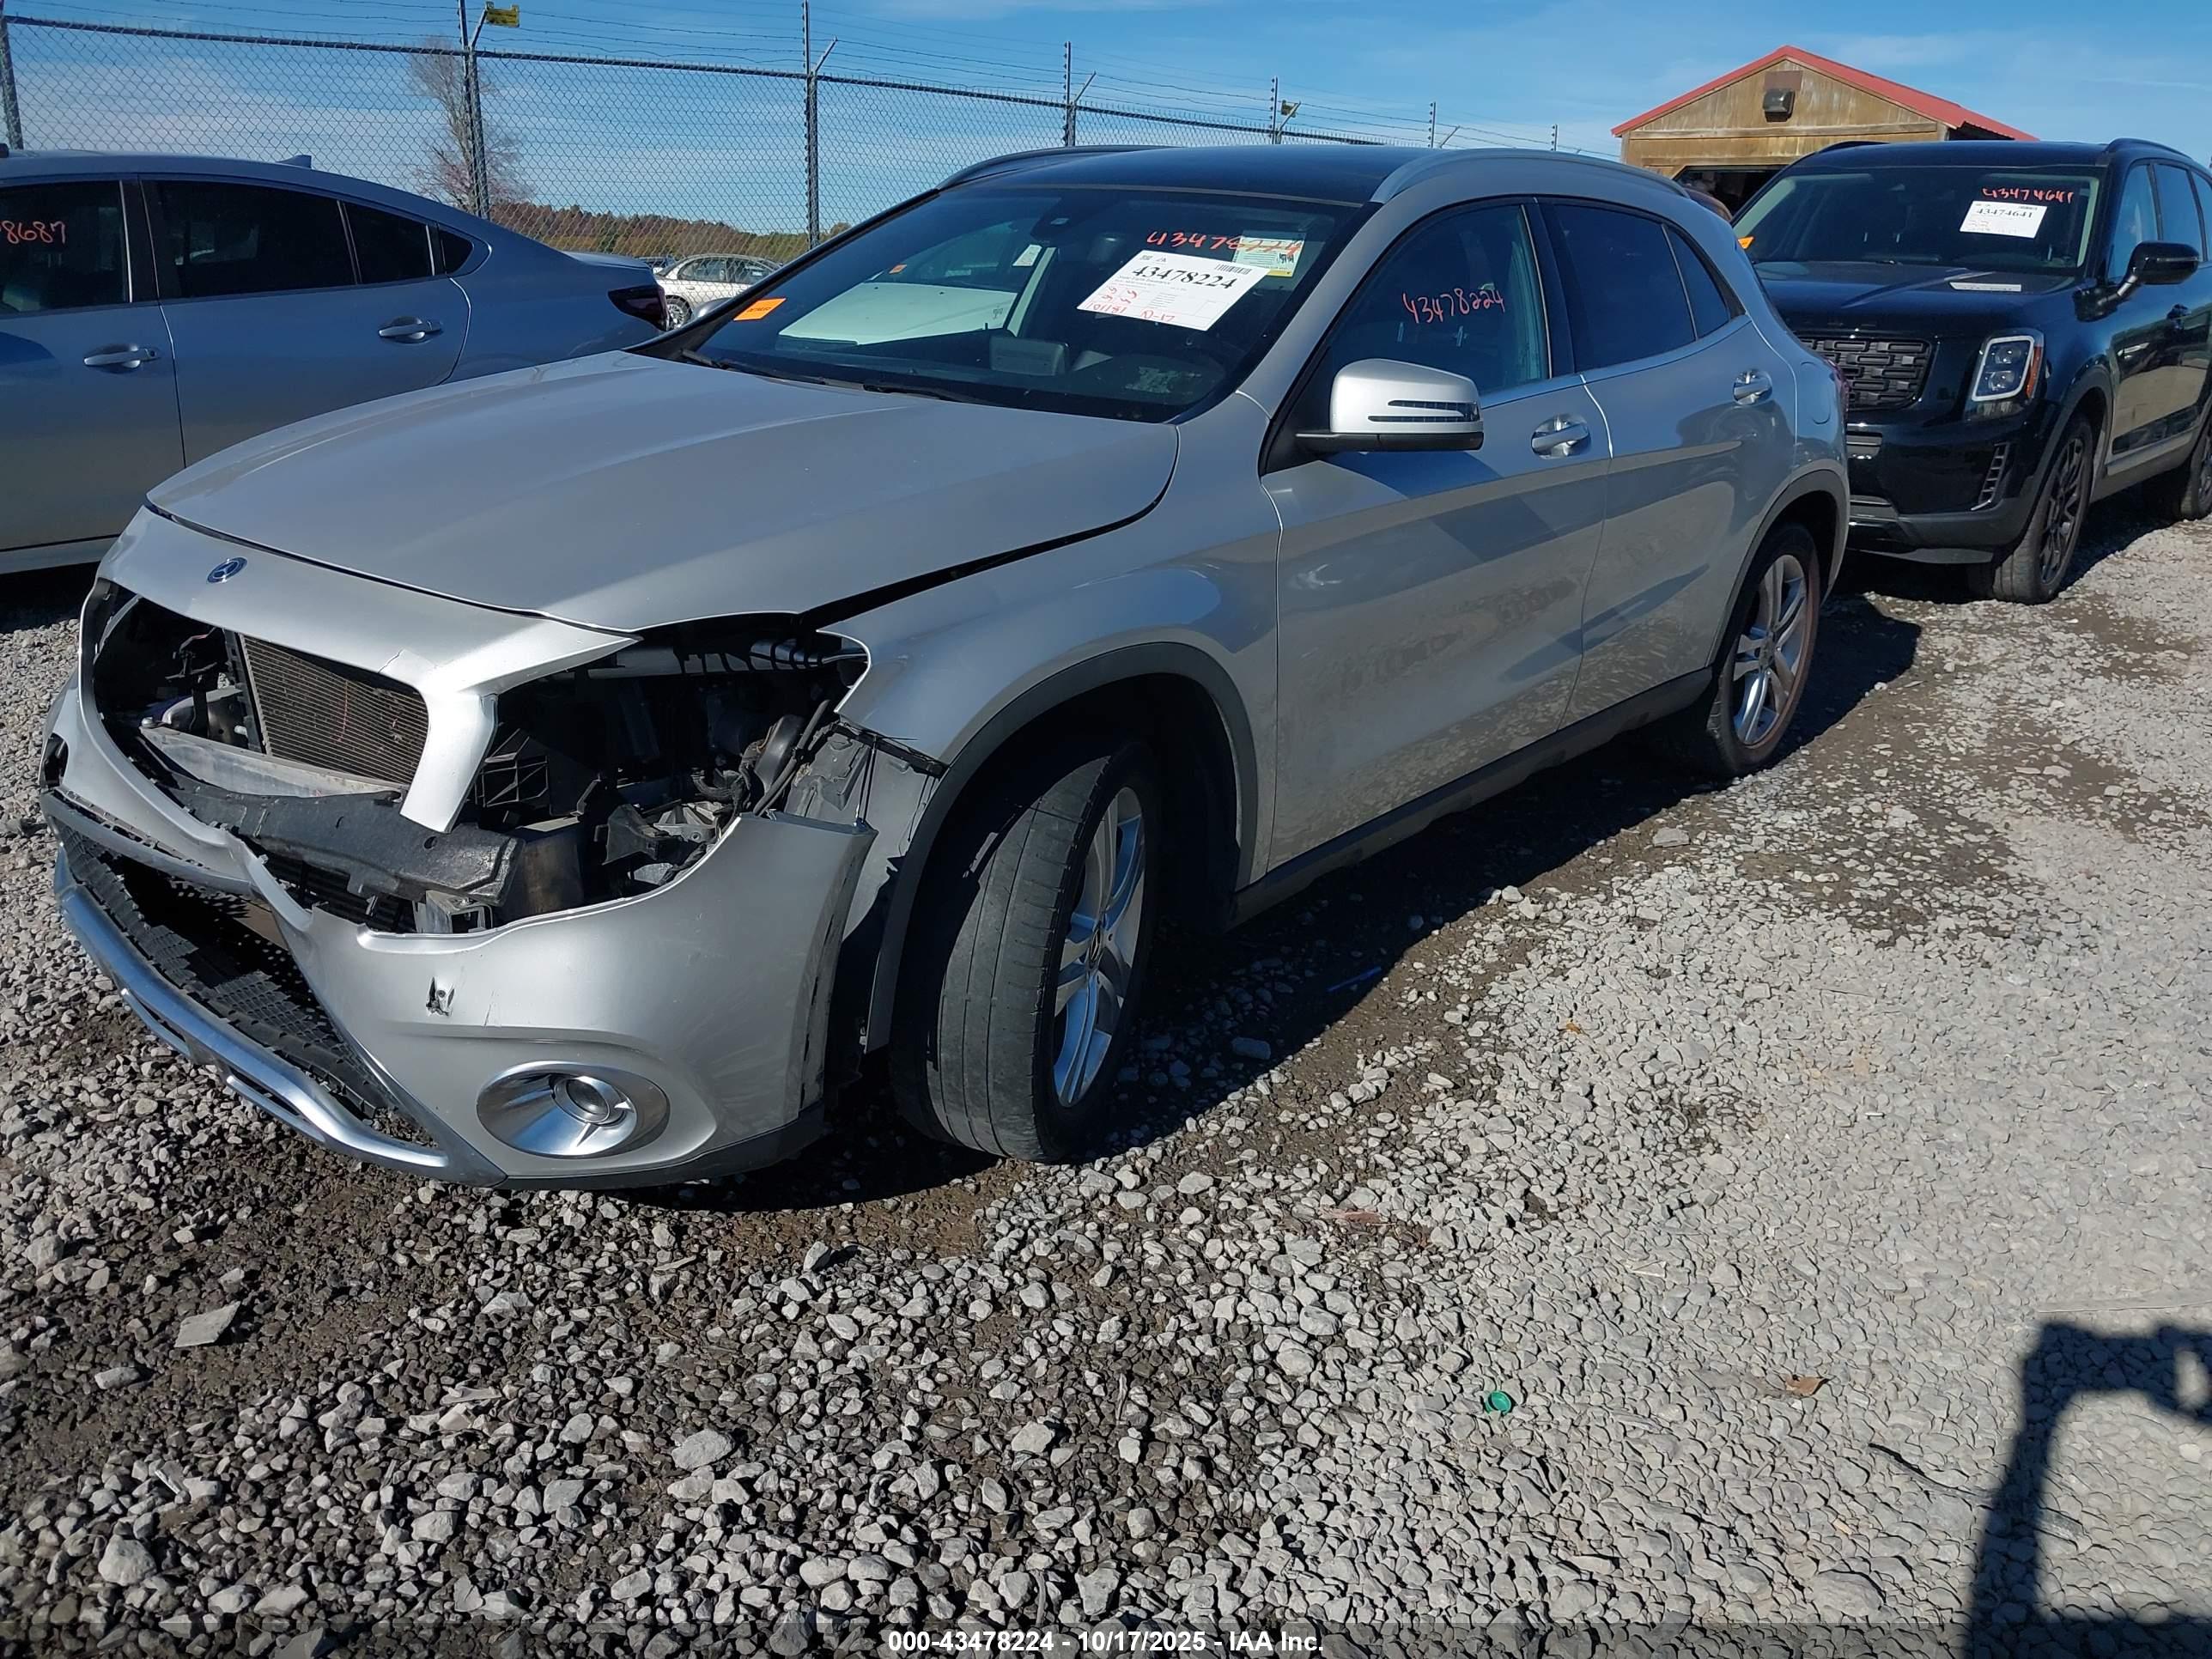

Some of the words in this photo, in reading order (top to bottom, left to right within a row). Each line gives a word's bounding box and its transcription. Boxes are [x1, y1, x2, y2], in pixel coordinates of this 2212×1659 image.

[1982, 187, 2075, 204] 43474641
[1976, 208, 2033, 218] 43474641
[0, 220, 65, 244] 8687
[1146, 231, 1303, 257] 43478224
[1132, 264, 1238, 289] 43478224
[1402, 288, 1505, 324] 43478224
